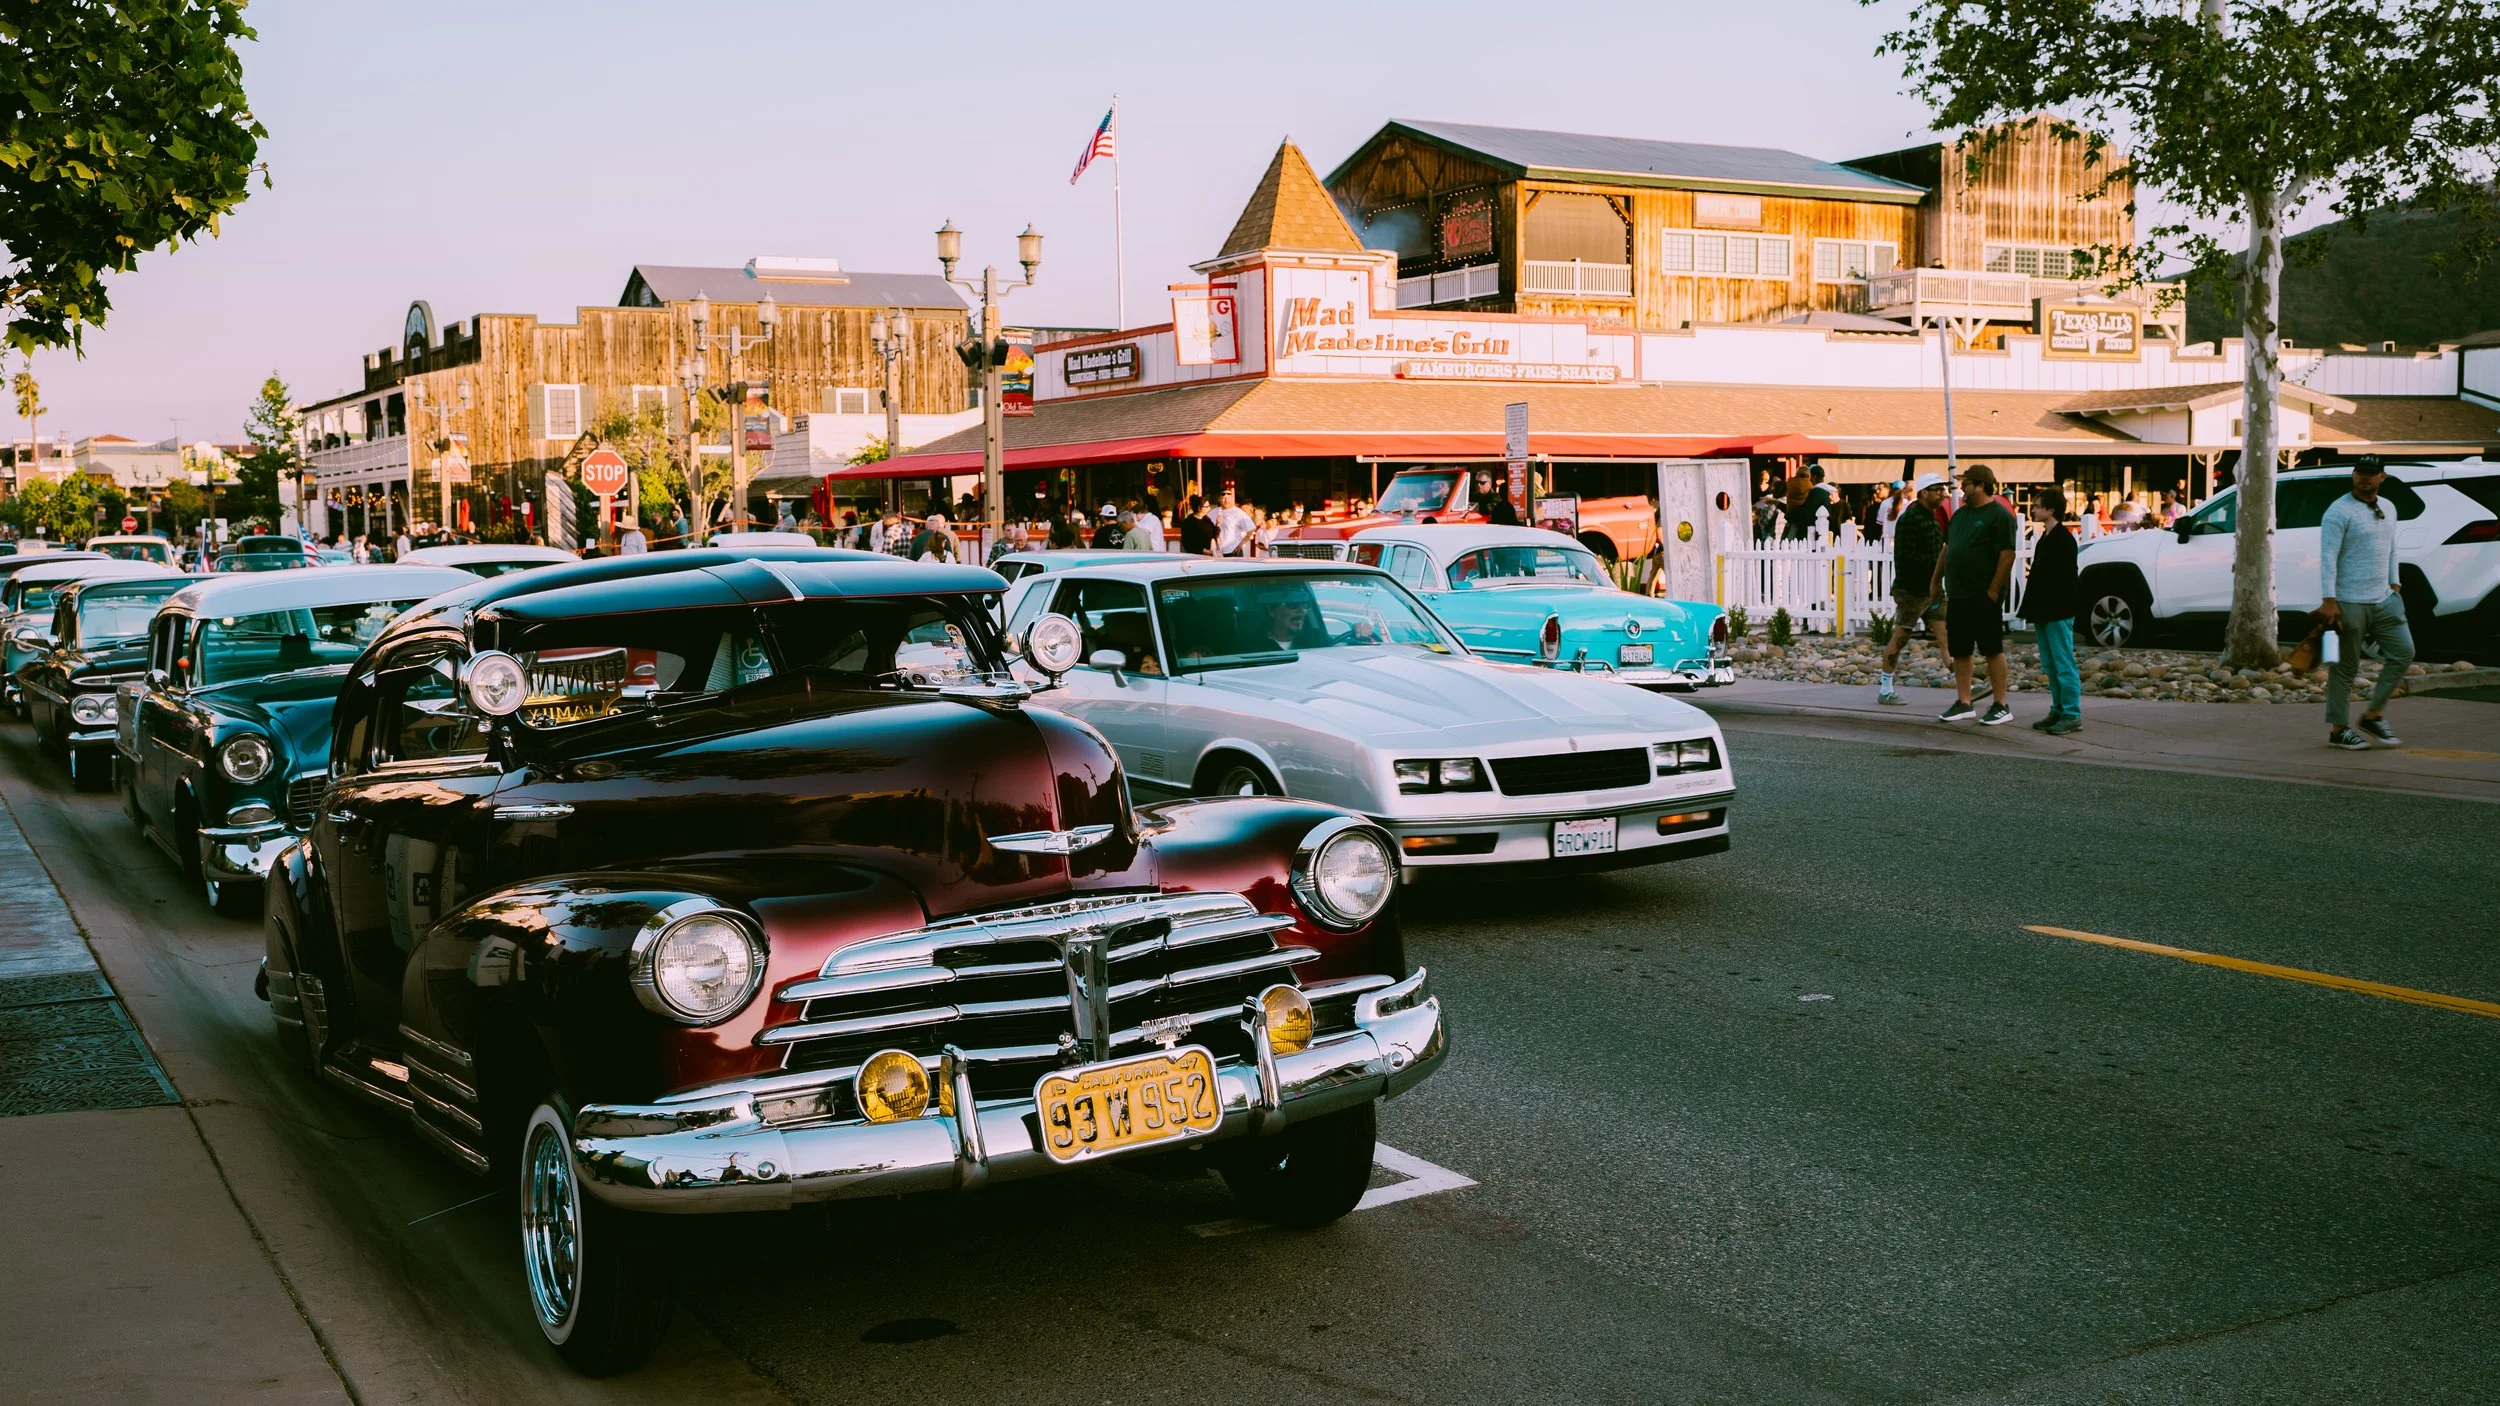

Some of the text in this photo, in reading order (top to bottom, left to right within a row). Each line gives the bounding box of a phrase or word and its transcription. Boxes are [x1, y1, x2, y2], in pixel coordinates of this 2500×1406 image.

[1288, 297, 1355, 331] Mad
[2051, 310, 2099, 335] TEXAS
[1283, 329, 1510, 357] Madeline's Grill
[1067, 348, 1132, 371] Mad Madeline's Grill
[586, 464, 624, 481] STOP
[1557, 830, 1613, 853] 5RCW911
[1081, 1063, 1168, 1090] CALIFORNIA
[1180, 1057, 1199, 1070] 47
[1050, 1073, 1212, 1148] 93 W 952
